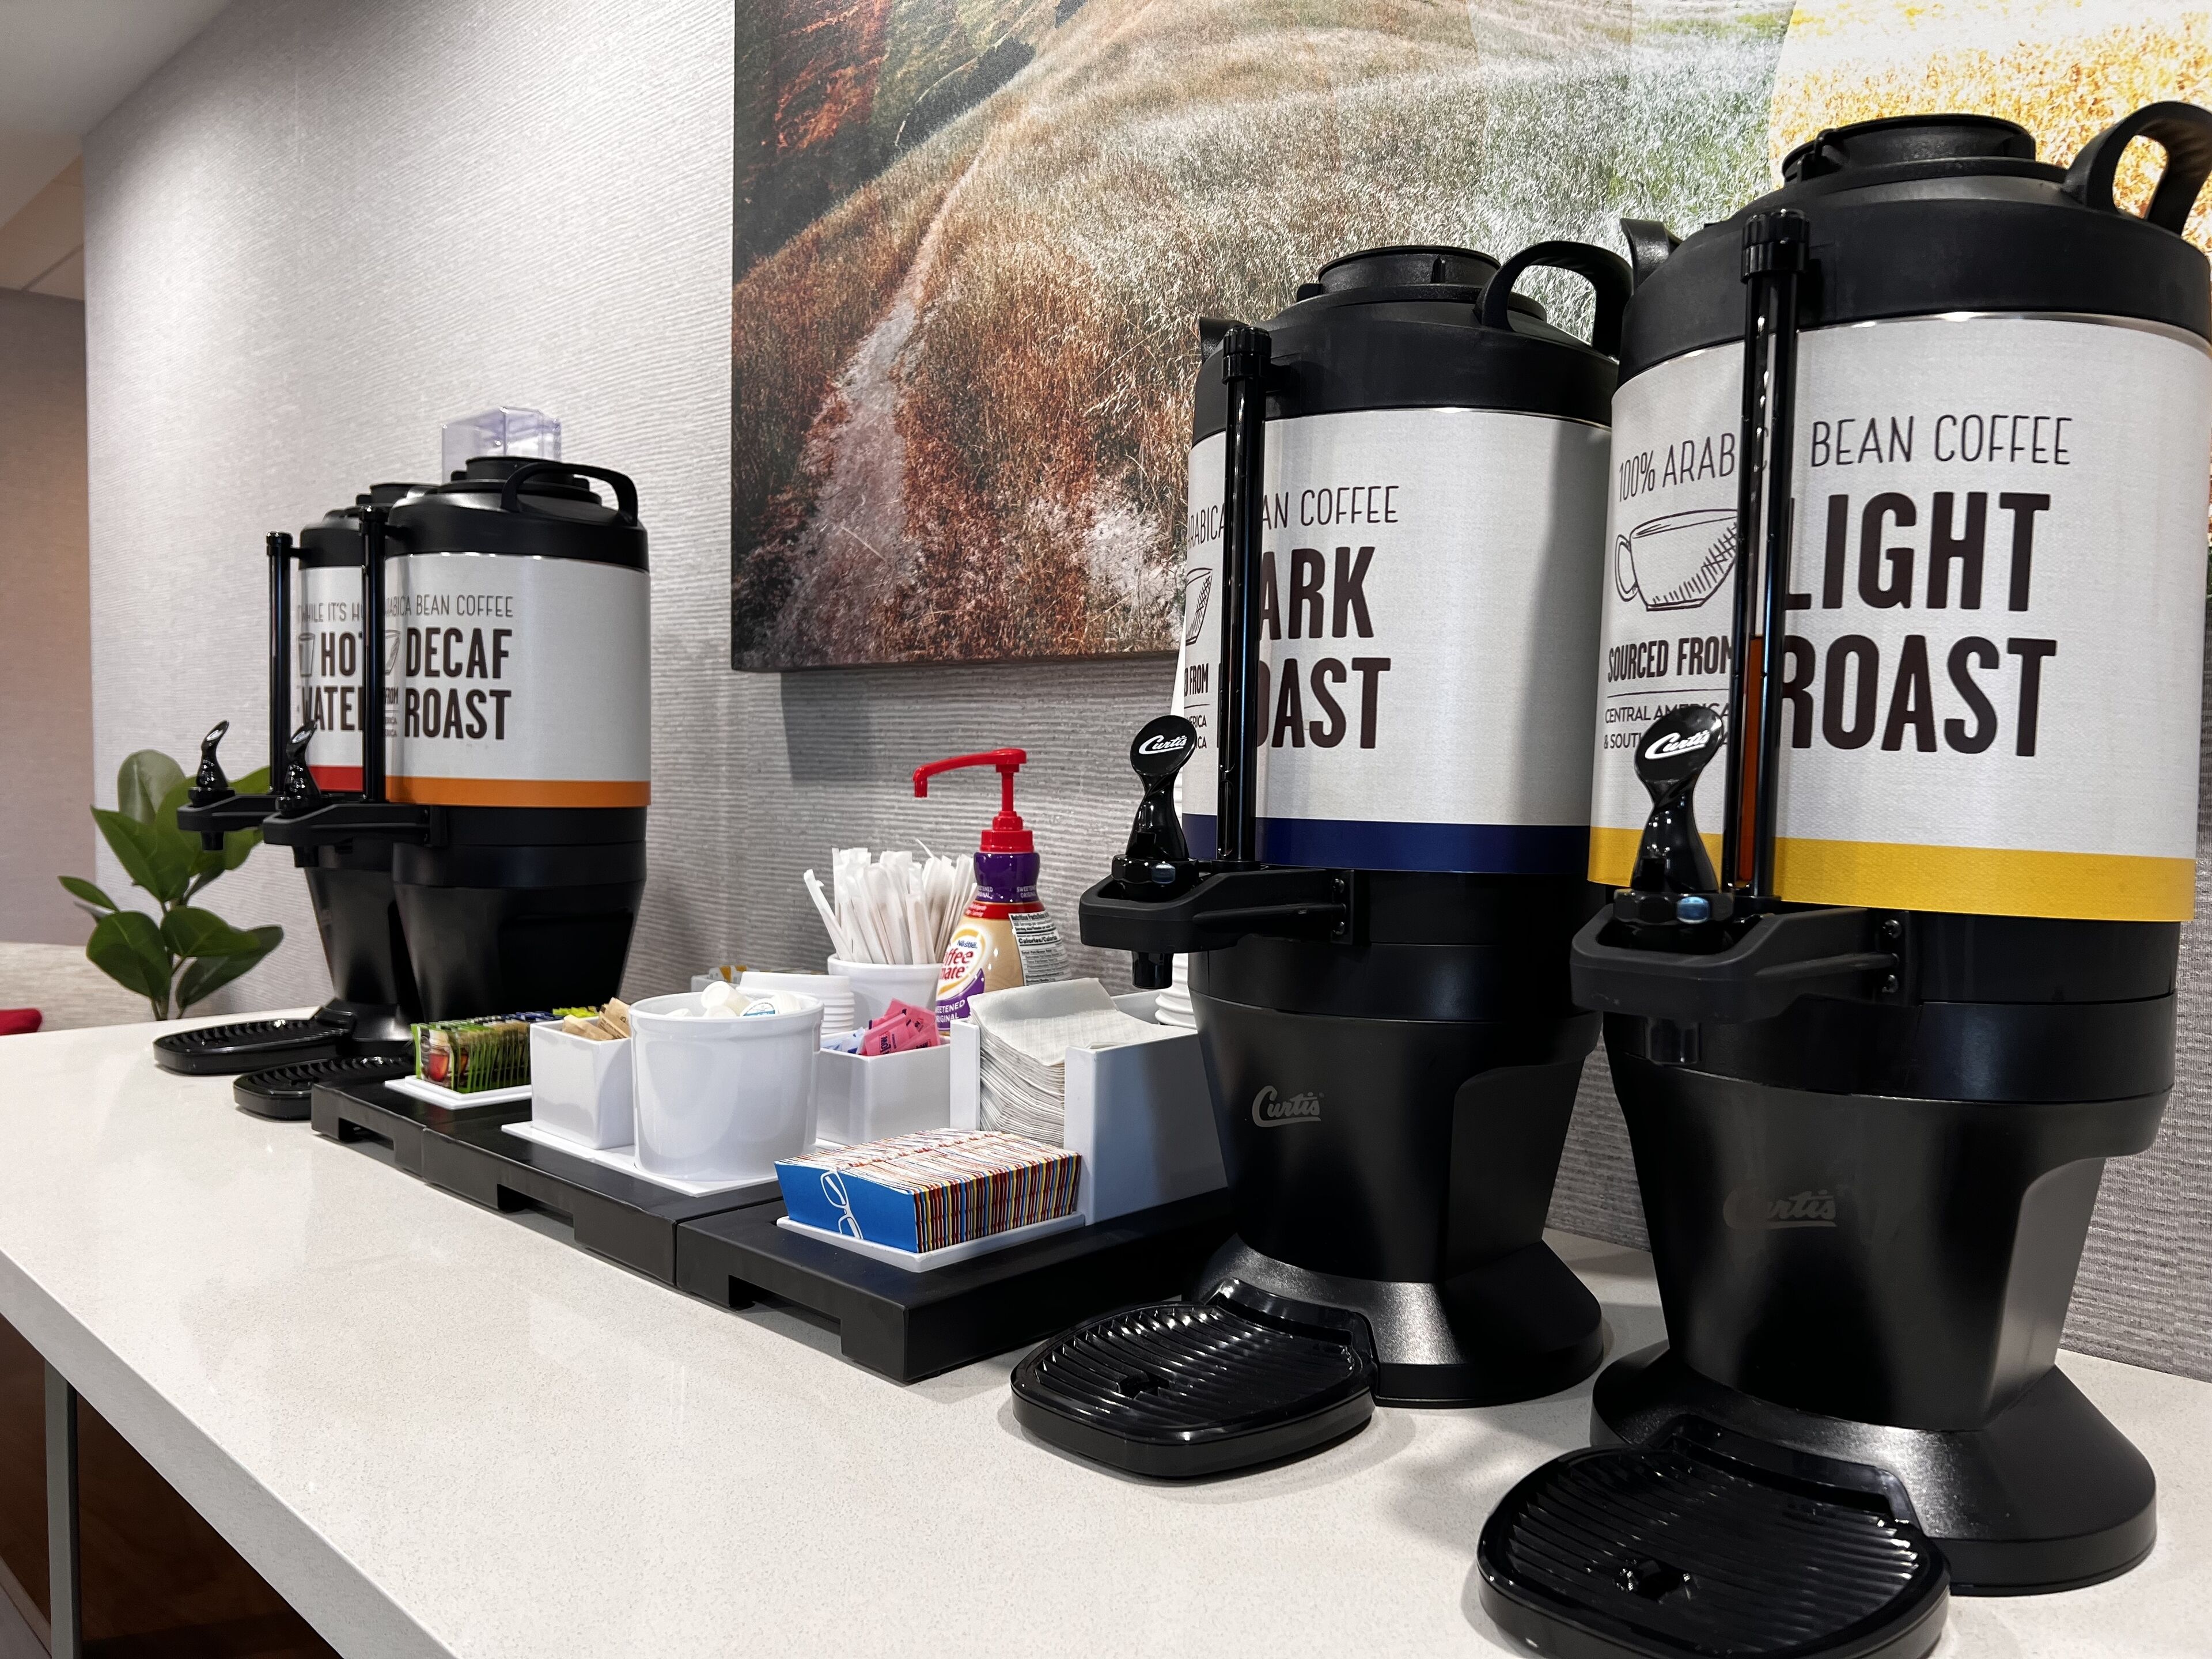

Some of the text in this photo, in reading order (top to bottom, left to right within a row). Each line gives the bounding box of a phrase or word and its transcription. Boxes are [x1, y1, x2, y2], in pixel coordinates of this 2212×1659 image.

[1619, 414, 2073, 502] 100% ARAB BEAN COFFEE
[1262, 491, 1289, 530] AN
[1301, 486, 1399, 527] COFFEE
[416, 594, 450, 616] BEAN
[457, 594, 514, 618] COFFEE
[1260, 546, 1376, 641] ARK
[406, 626, 513, 679] DECAF
[1608, 639, 1669, 683] SOURCED
[1190, 662, 1209, 696] FROM
[404, 687, 512, 740] ROAST
[1605, 705, 1652, 724] CENTRAL
[1138, 734, 1188, 755] Curtis
[1645, 729, 1710, 760] Curtis
[1252, 1085, 1322, 1128] Curtis
